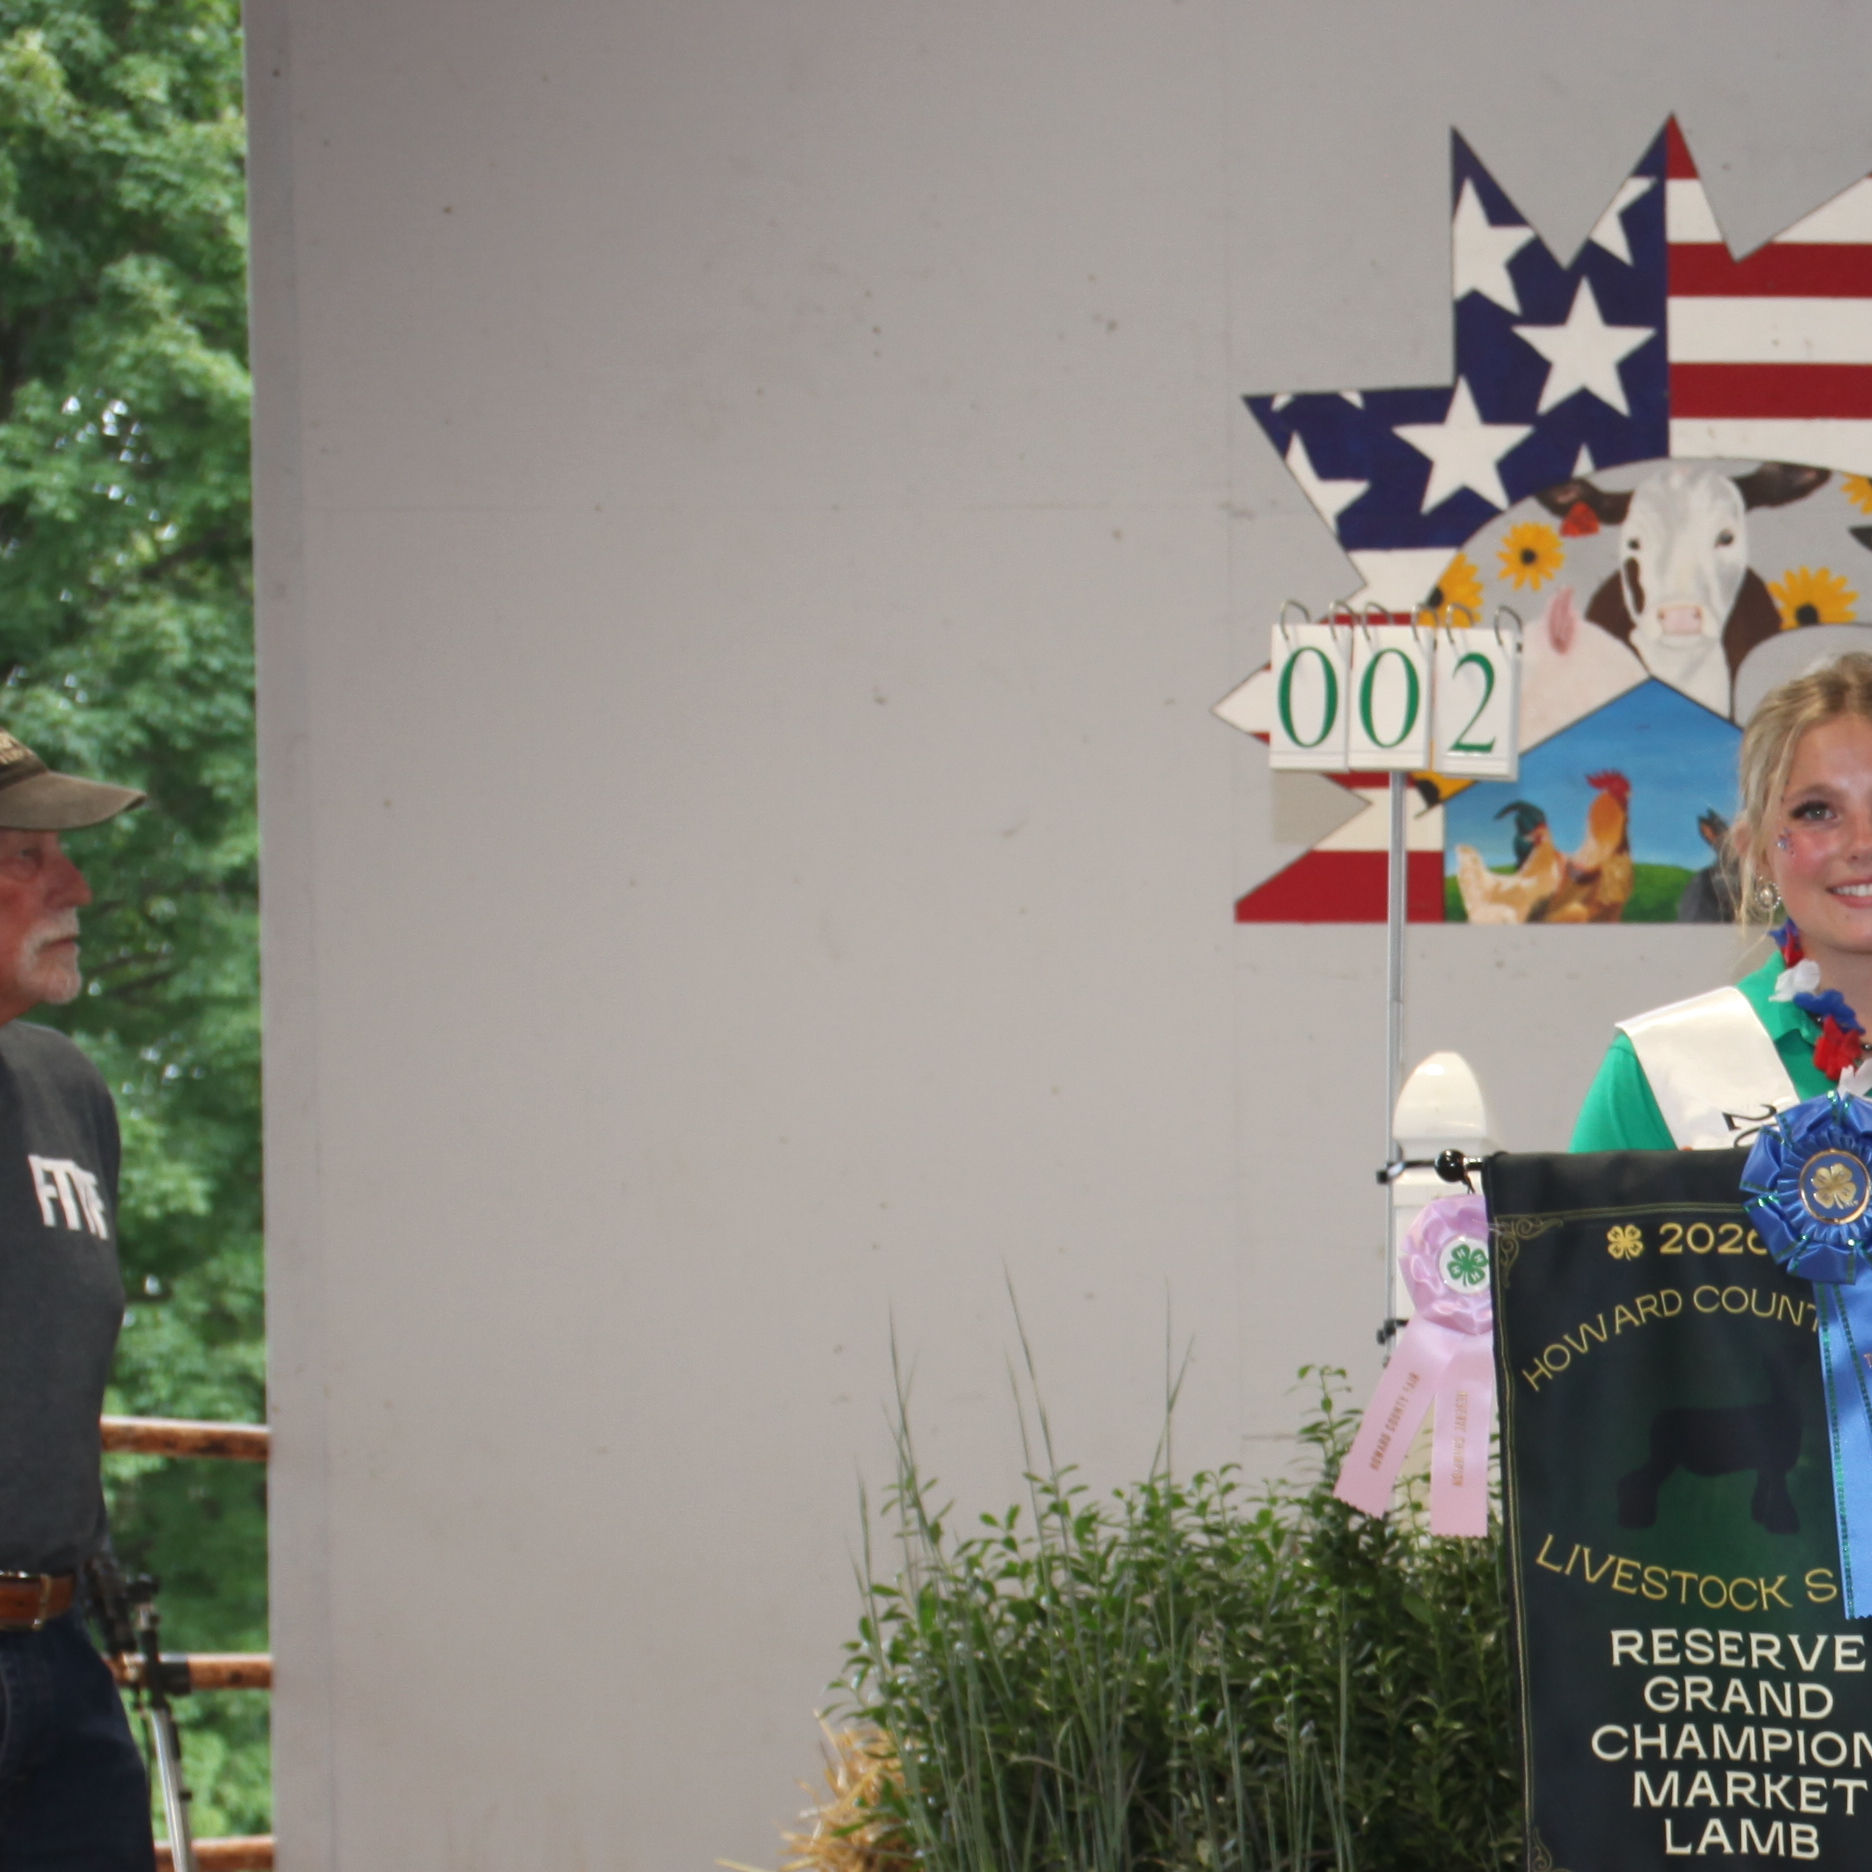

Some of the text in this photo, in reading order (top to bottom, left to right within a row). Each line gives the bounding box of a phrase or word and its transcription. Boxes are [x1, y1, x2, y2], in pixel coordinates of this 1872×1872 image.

[1278, 646, 1496, 752] 002
[1522, 1285, 1818, 1392] HOWARD COUNT
[1536, 1534, 1793, 1611] LIVESTOCK
[1610, 1628, 1866, 1672] RESERVE
[1644, 1675, 1834, 1720] GRAND
[1633, 1770, 1868, 1816] MARKET
[1664, 1818, 1820, 1861] LAMB
